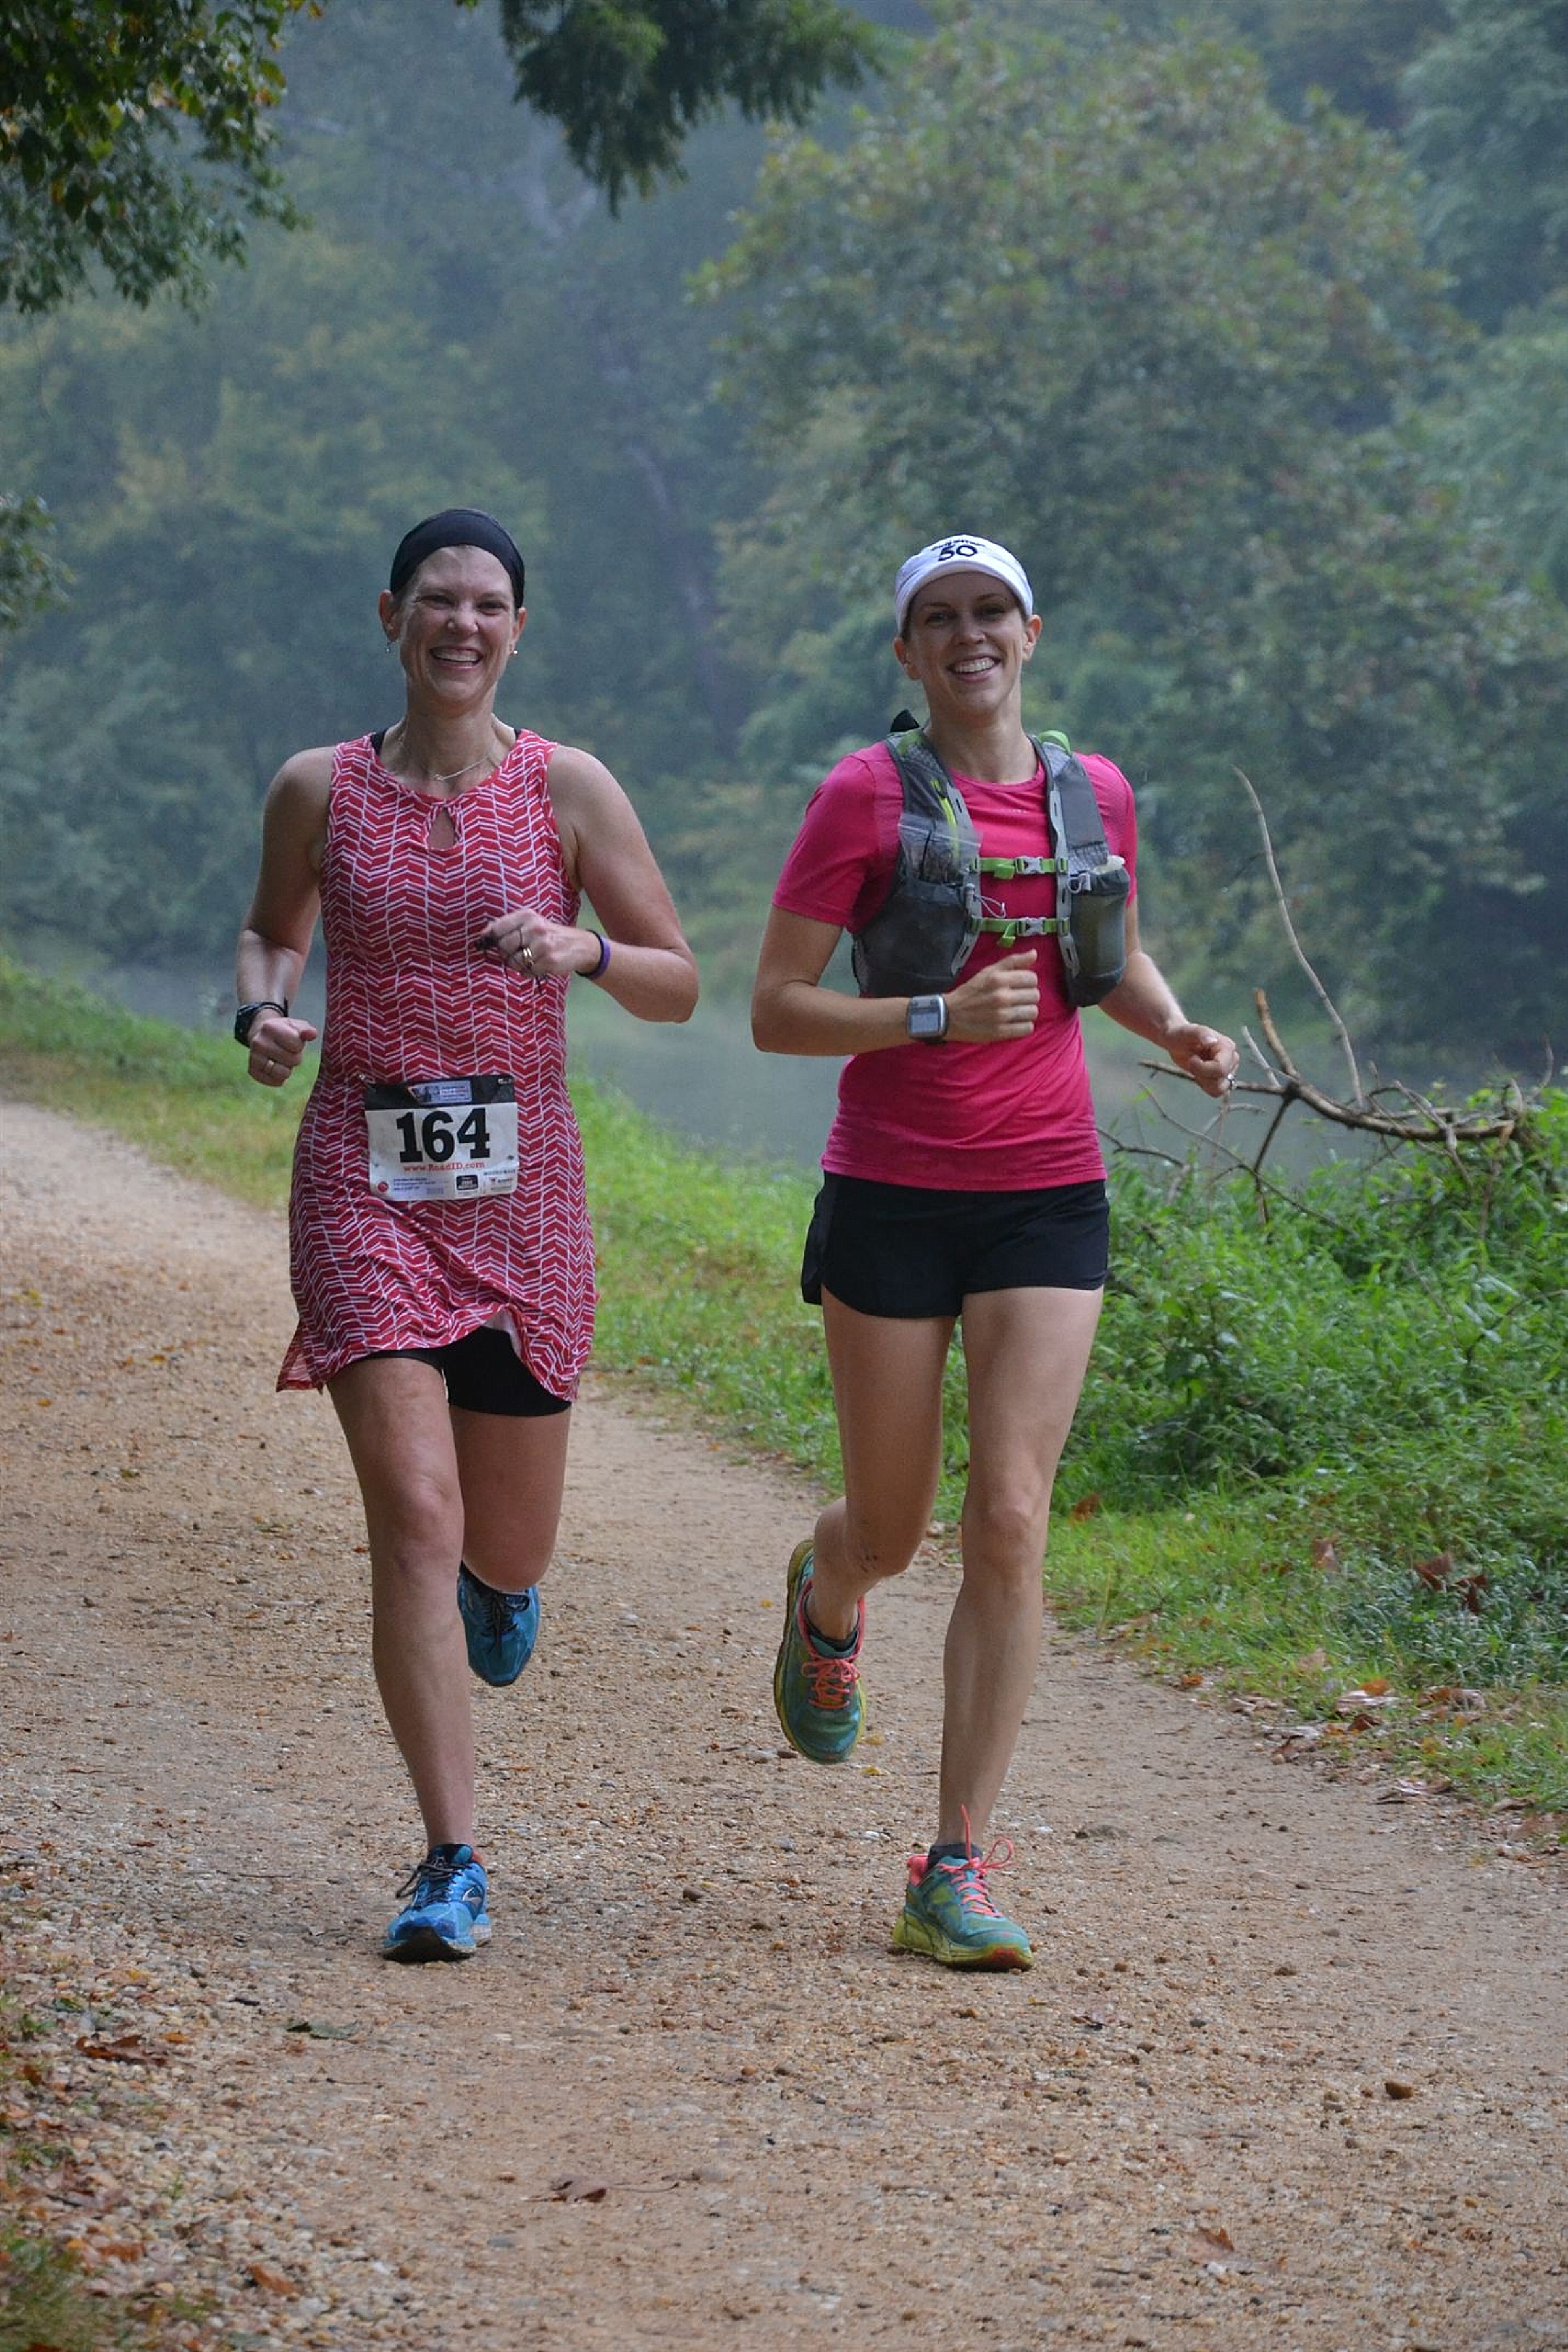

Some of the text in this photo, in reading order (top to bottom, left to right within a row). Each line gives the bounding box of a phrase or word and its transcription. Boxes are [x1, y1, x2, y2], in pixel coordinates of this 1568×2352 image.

[938, 544, 978, 562] 50
[395, 1107, 491, 1163] 164
[403, 1162, 485, 1173] www.RoadID.com
